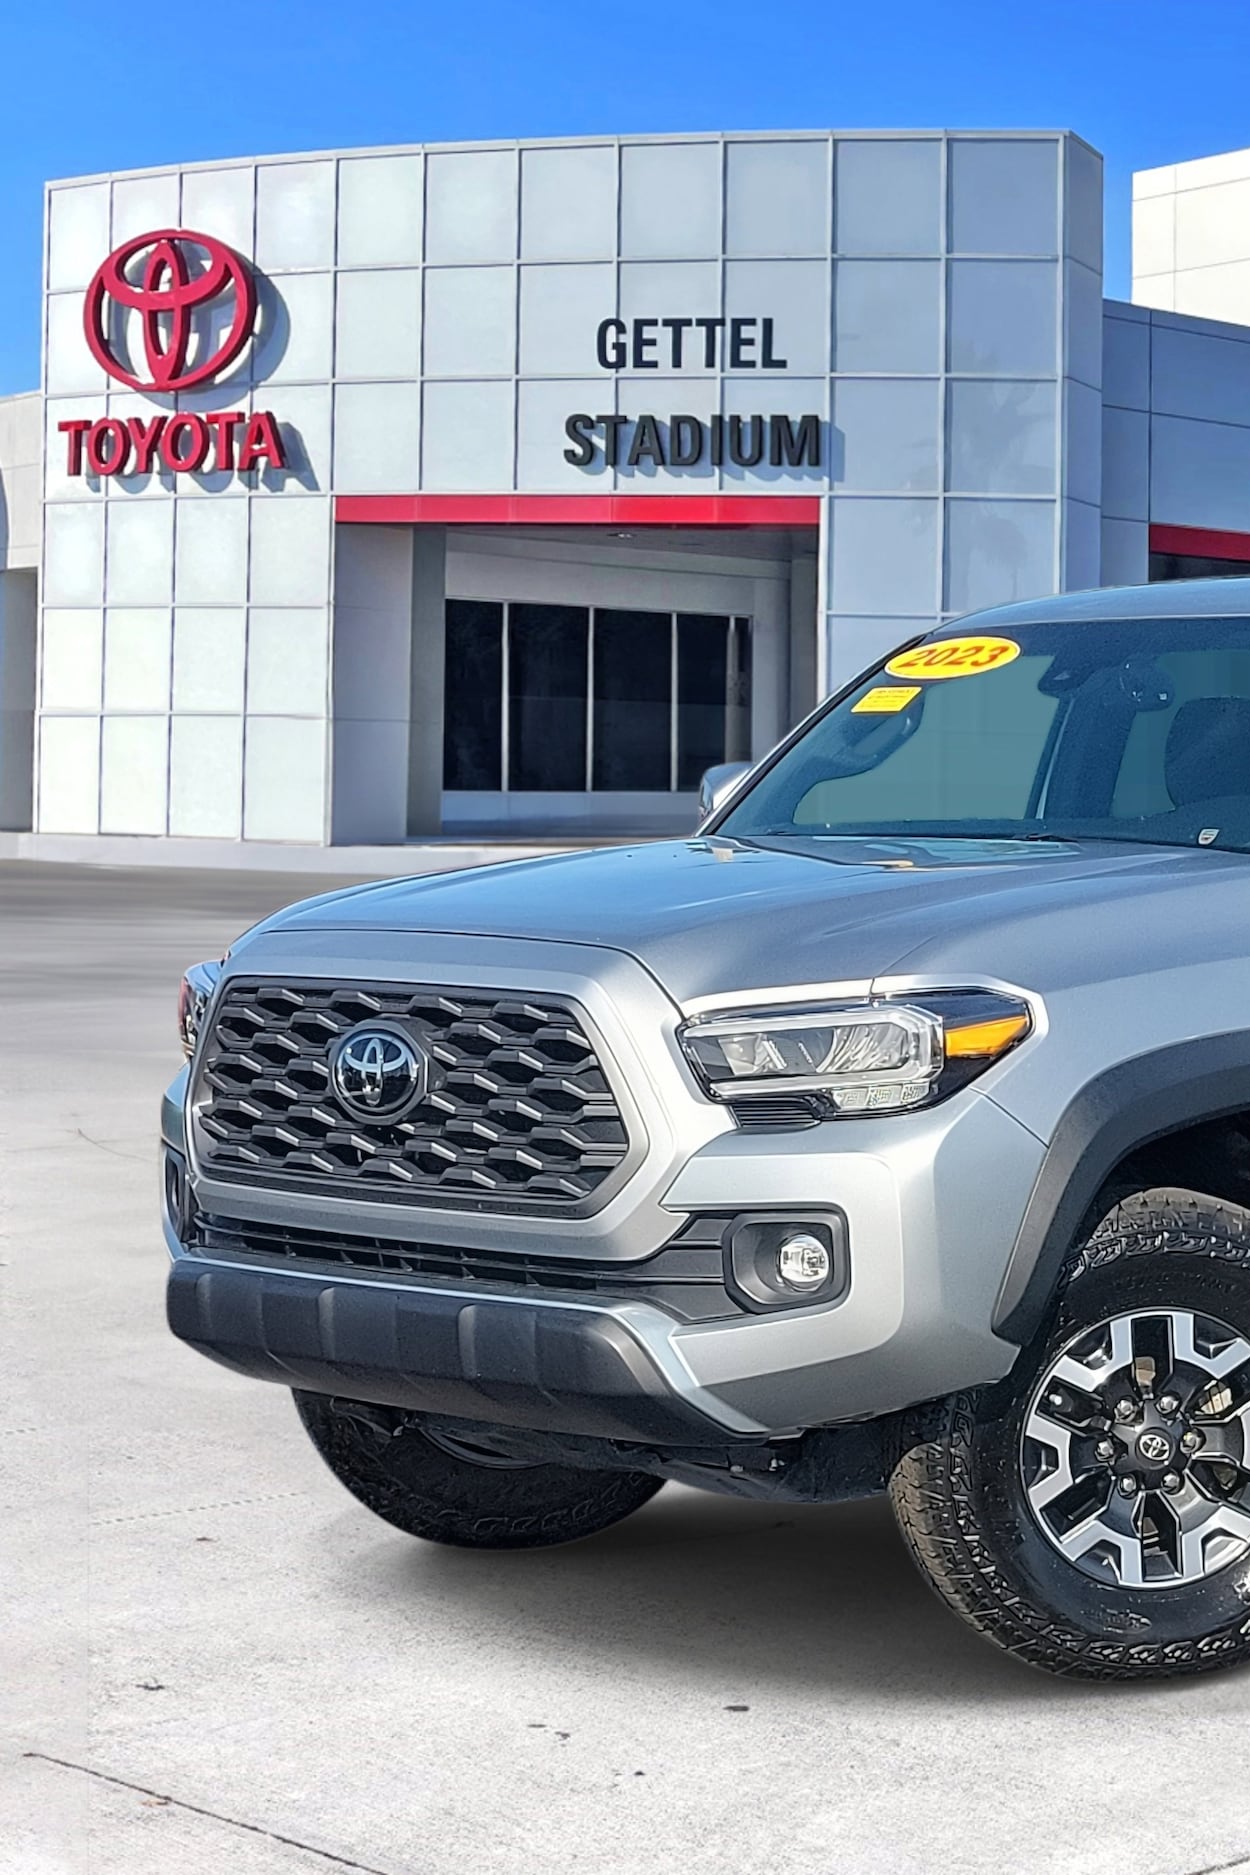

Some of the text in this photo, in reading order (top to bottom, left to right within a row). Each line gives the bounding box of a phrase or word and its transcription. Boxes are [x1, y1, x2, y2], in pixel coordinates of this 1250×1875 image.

[596, 317, 788, 370] GETTEL
[57, 411, 290, 477] TOYOTA
[563, 413, 822, 467] STADIUM
[896, 645, 1010, 668] 2023
